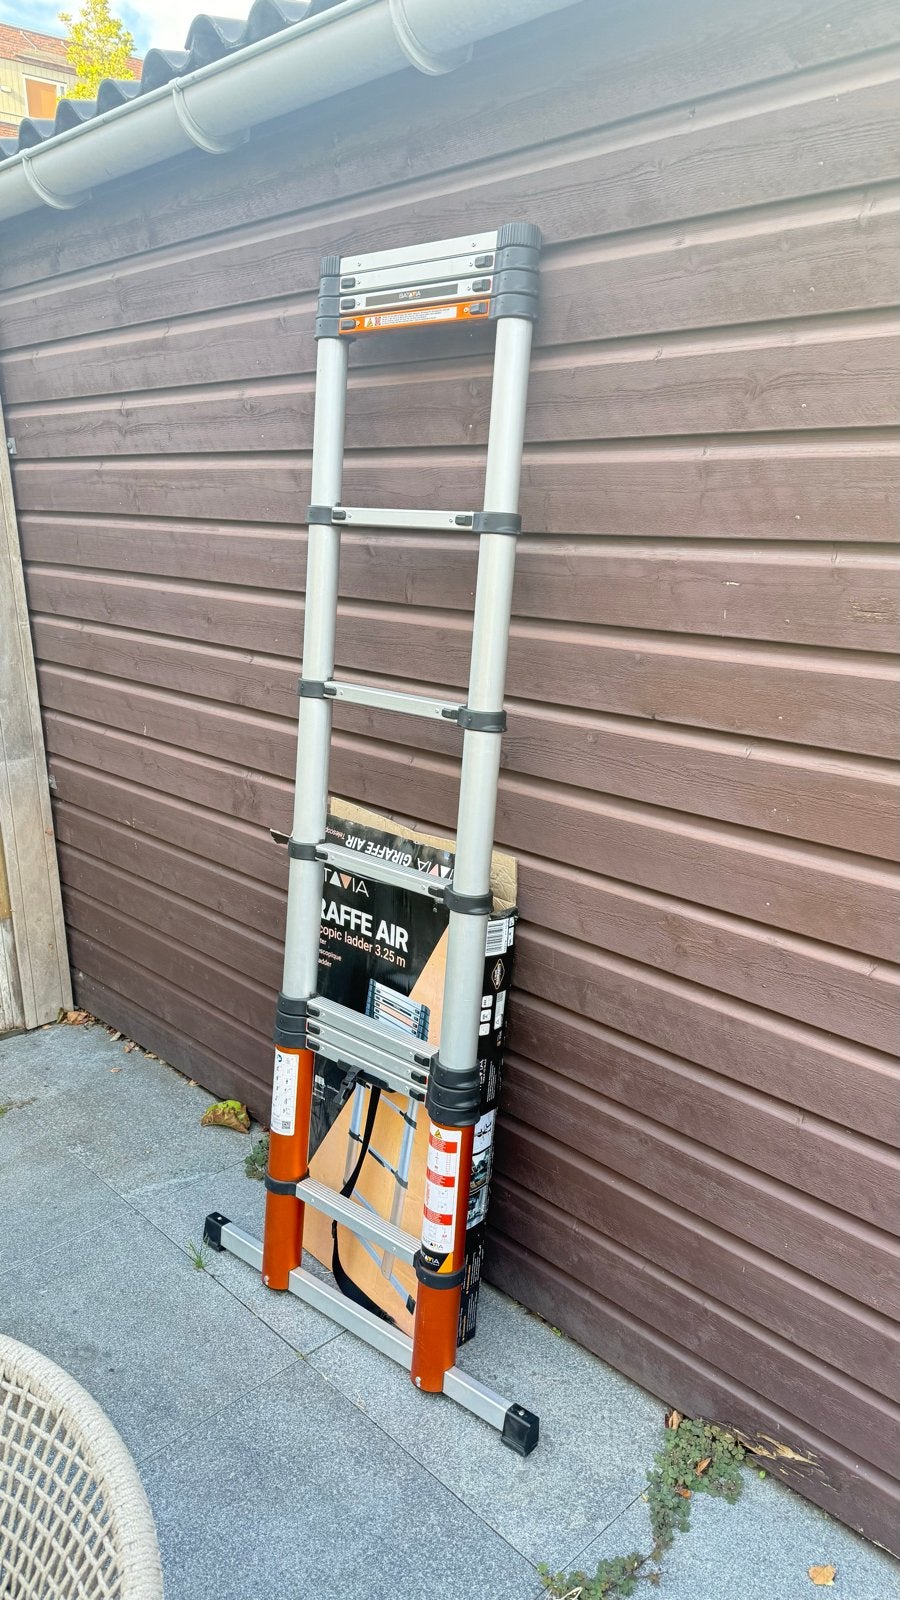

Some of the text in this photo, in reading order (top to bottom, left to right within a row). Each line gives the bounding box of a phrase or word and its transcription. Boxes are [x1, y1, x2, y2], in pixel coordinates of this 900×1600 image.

[345, 834, 366, 851] AIR
[364, 841, 412, 867] GIRAFFE
[324, 867, 369, 898] TAVIA
[417, 857, 454, 880] AVIA
[321, 898, 408, 953] RAFFE AIR
[320, 924, 406, 968] copic ladder 3.25 m
